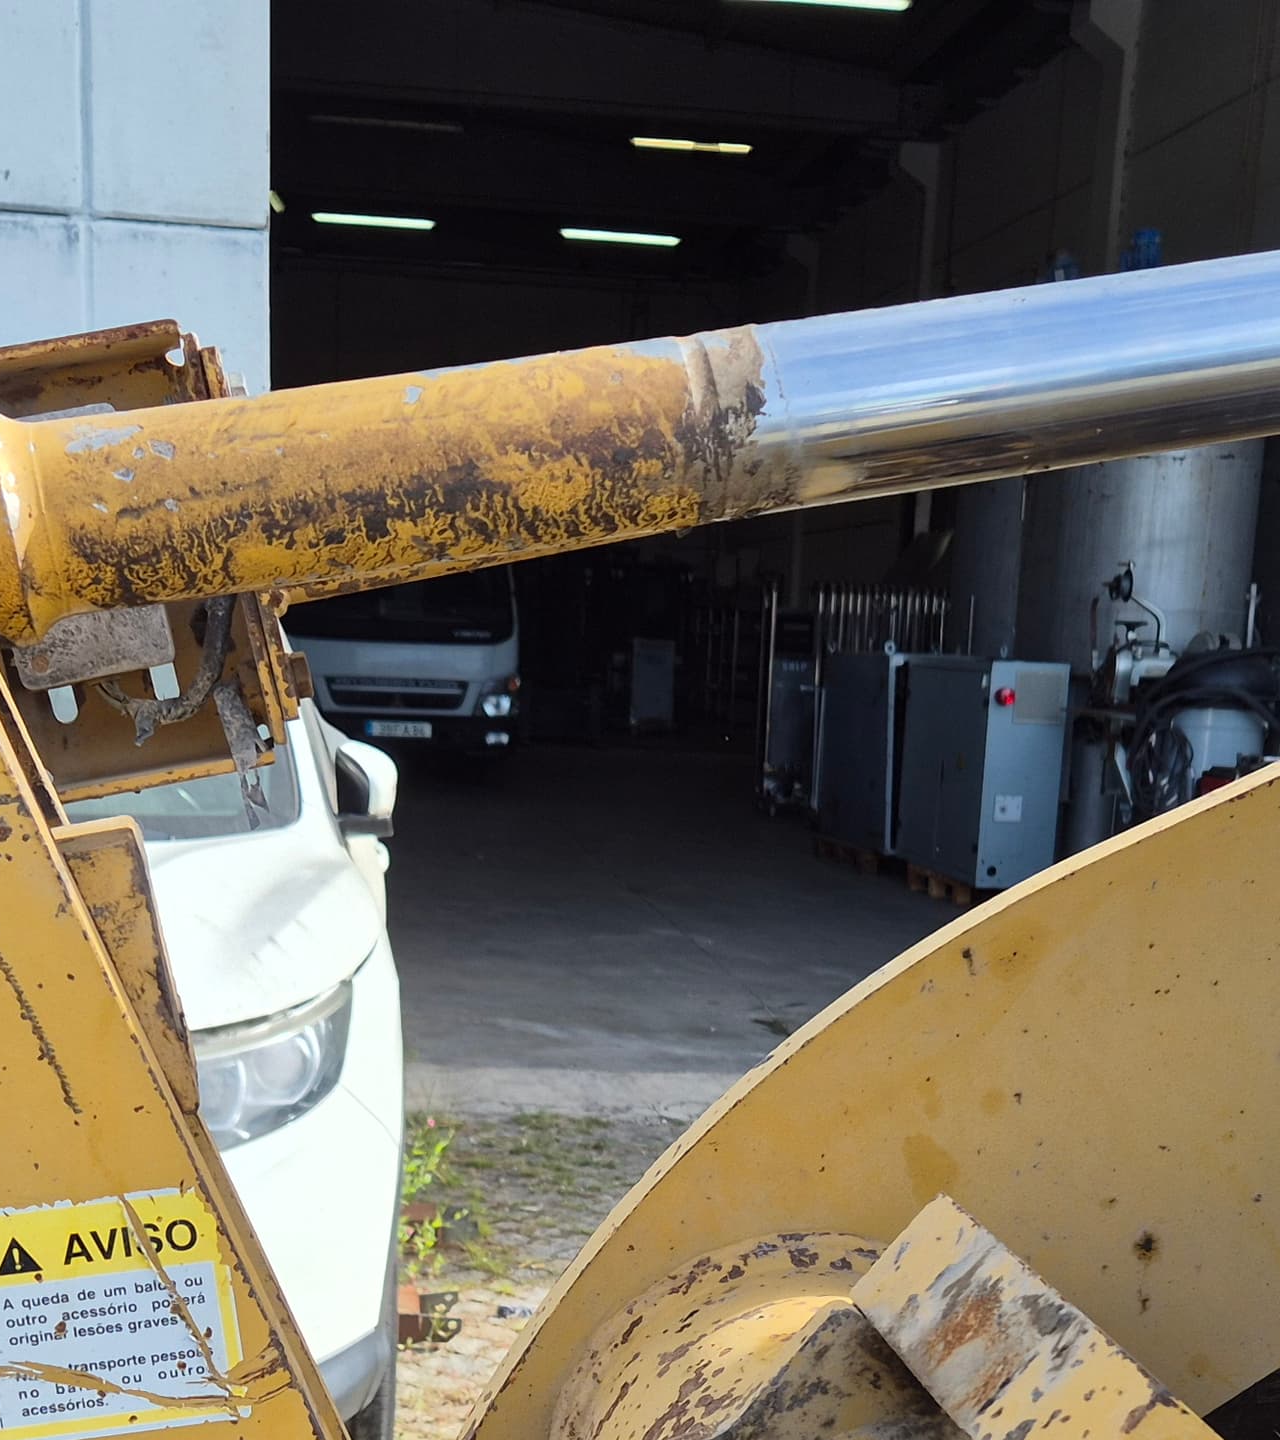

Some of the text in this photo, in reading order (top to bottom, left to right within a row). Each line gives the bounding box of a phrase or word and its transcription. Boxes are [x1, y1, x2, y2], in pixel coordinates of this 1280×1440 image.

[63, 1219, 198, 1266] AVISO
[3, 1277, 204, 1311] A queda de um bal ou
[6, 1292, 206, 1329] outro acessório poerá
[73, 1322, 124, 1338] lesões
[128, 1315, 179, 1333] graves
[68, 1355, 147, 1374] transporte
[18, 1388, 40, 1401] no
[121, 1374, 143, 1385] ou
[21, 1397, 110, 1417] acessórios.
